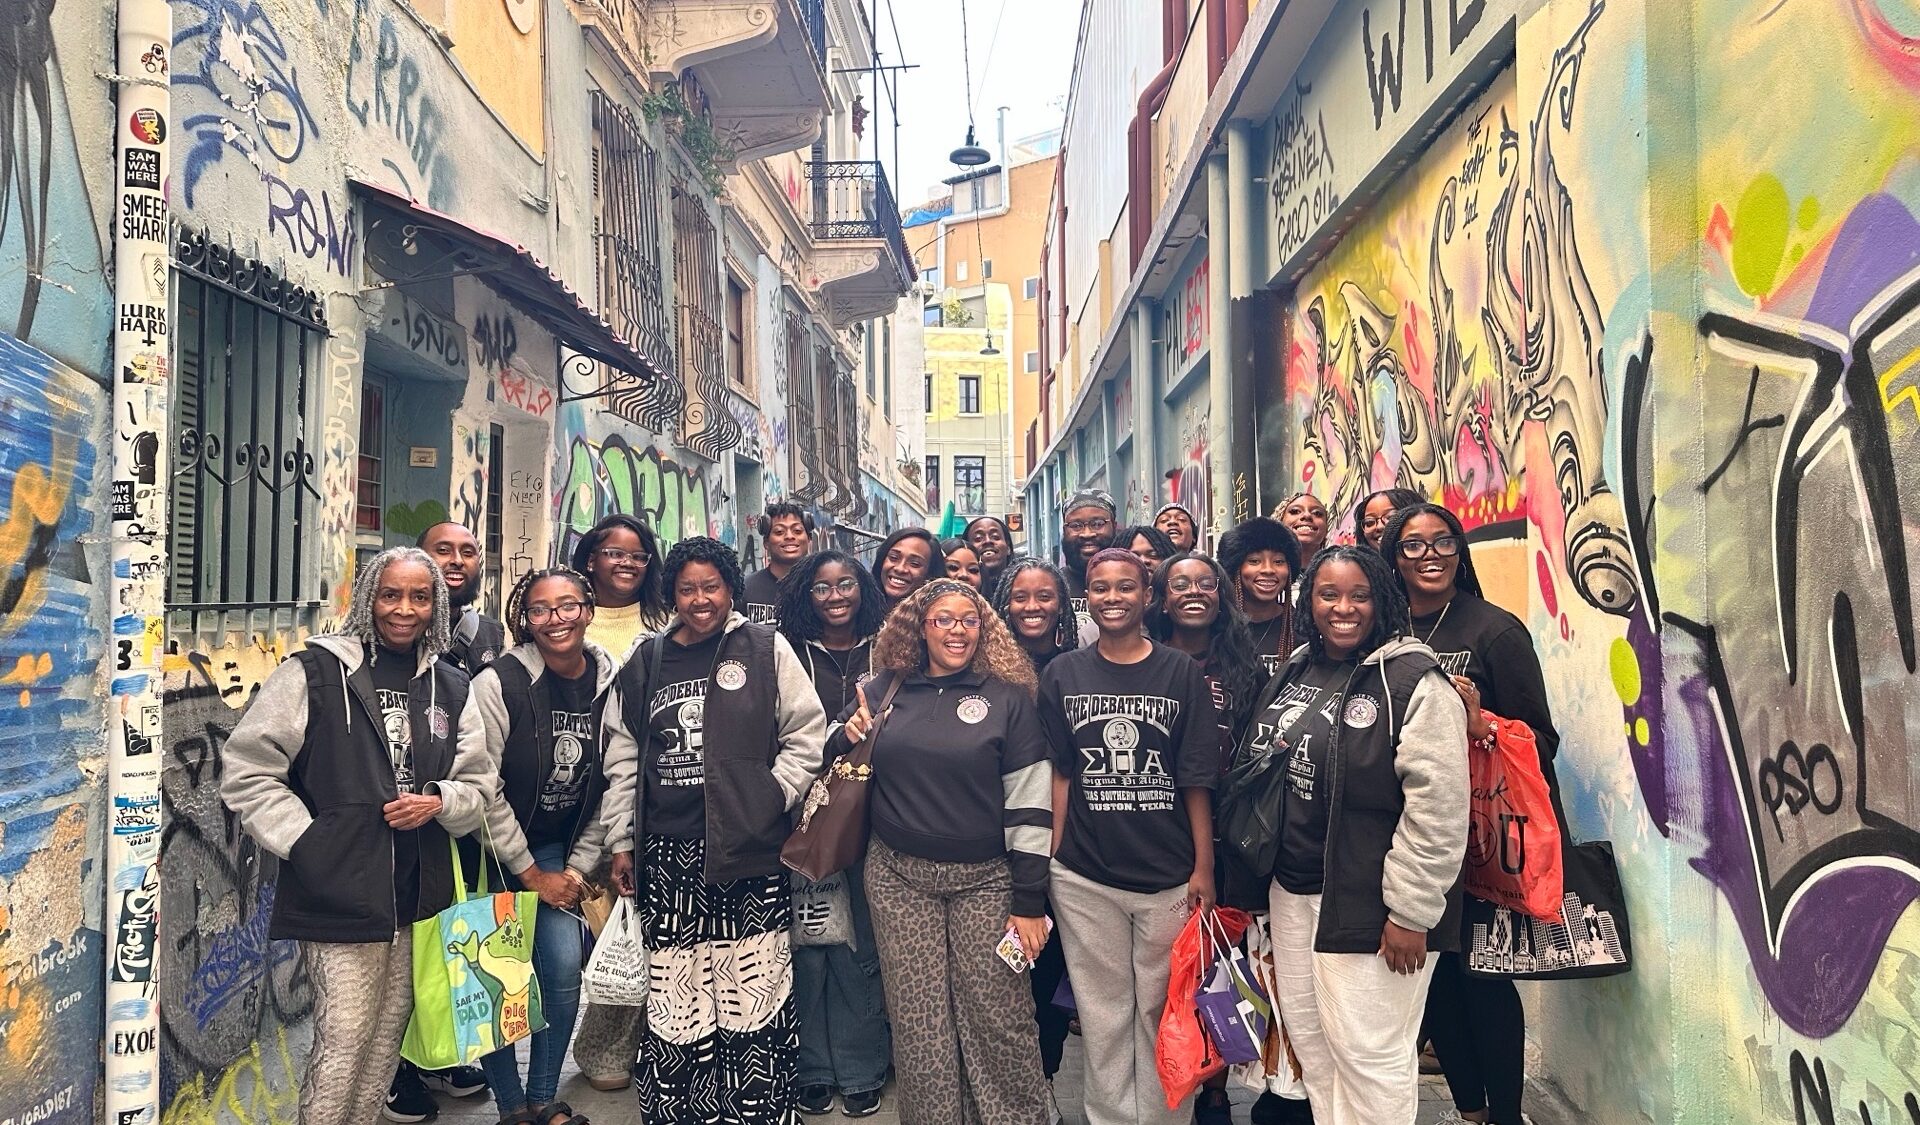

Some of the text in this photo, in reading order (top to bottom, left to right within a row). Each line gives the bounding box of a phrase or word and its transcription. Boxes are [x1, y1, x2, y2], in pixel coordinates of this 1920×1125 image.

[129, 151, 156, 163] SAM
[127, 161, 156, 173] WAS
[127, 170, 158, 183] HERE
[123, 194, 168, 222] SMEER
[123, 217, 168, 245] SHARK
[121, 304, 166, 322] LURK
[120, 318, 167, 337] HARD
[112, 504, 132, 514] ERE
[667, 678, 708, 706] DEBAT
[376, 689, 410, 714] EBAT
[1064, 694, 1090, 735] THE
[1089, 694, 1144, 722] DEBATE
[1082, 776, 1172, 788] Sigma Pi Alpha
[1139, 802, 1174, 812] TEXAS
[473, 990, 486, 1002] MY
[457, 1001, 490, 1026] PAD
[504, 1003, 527, 1020] DIG
